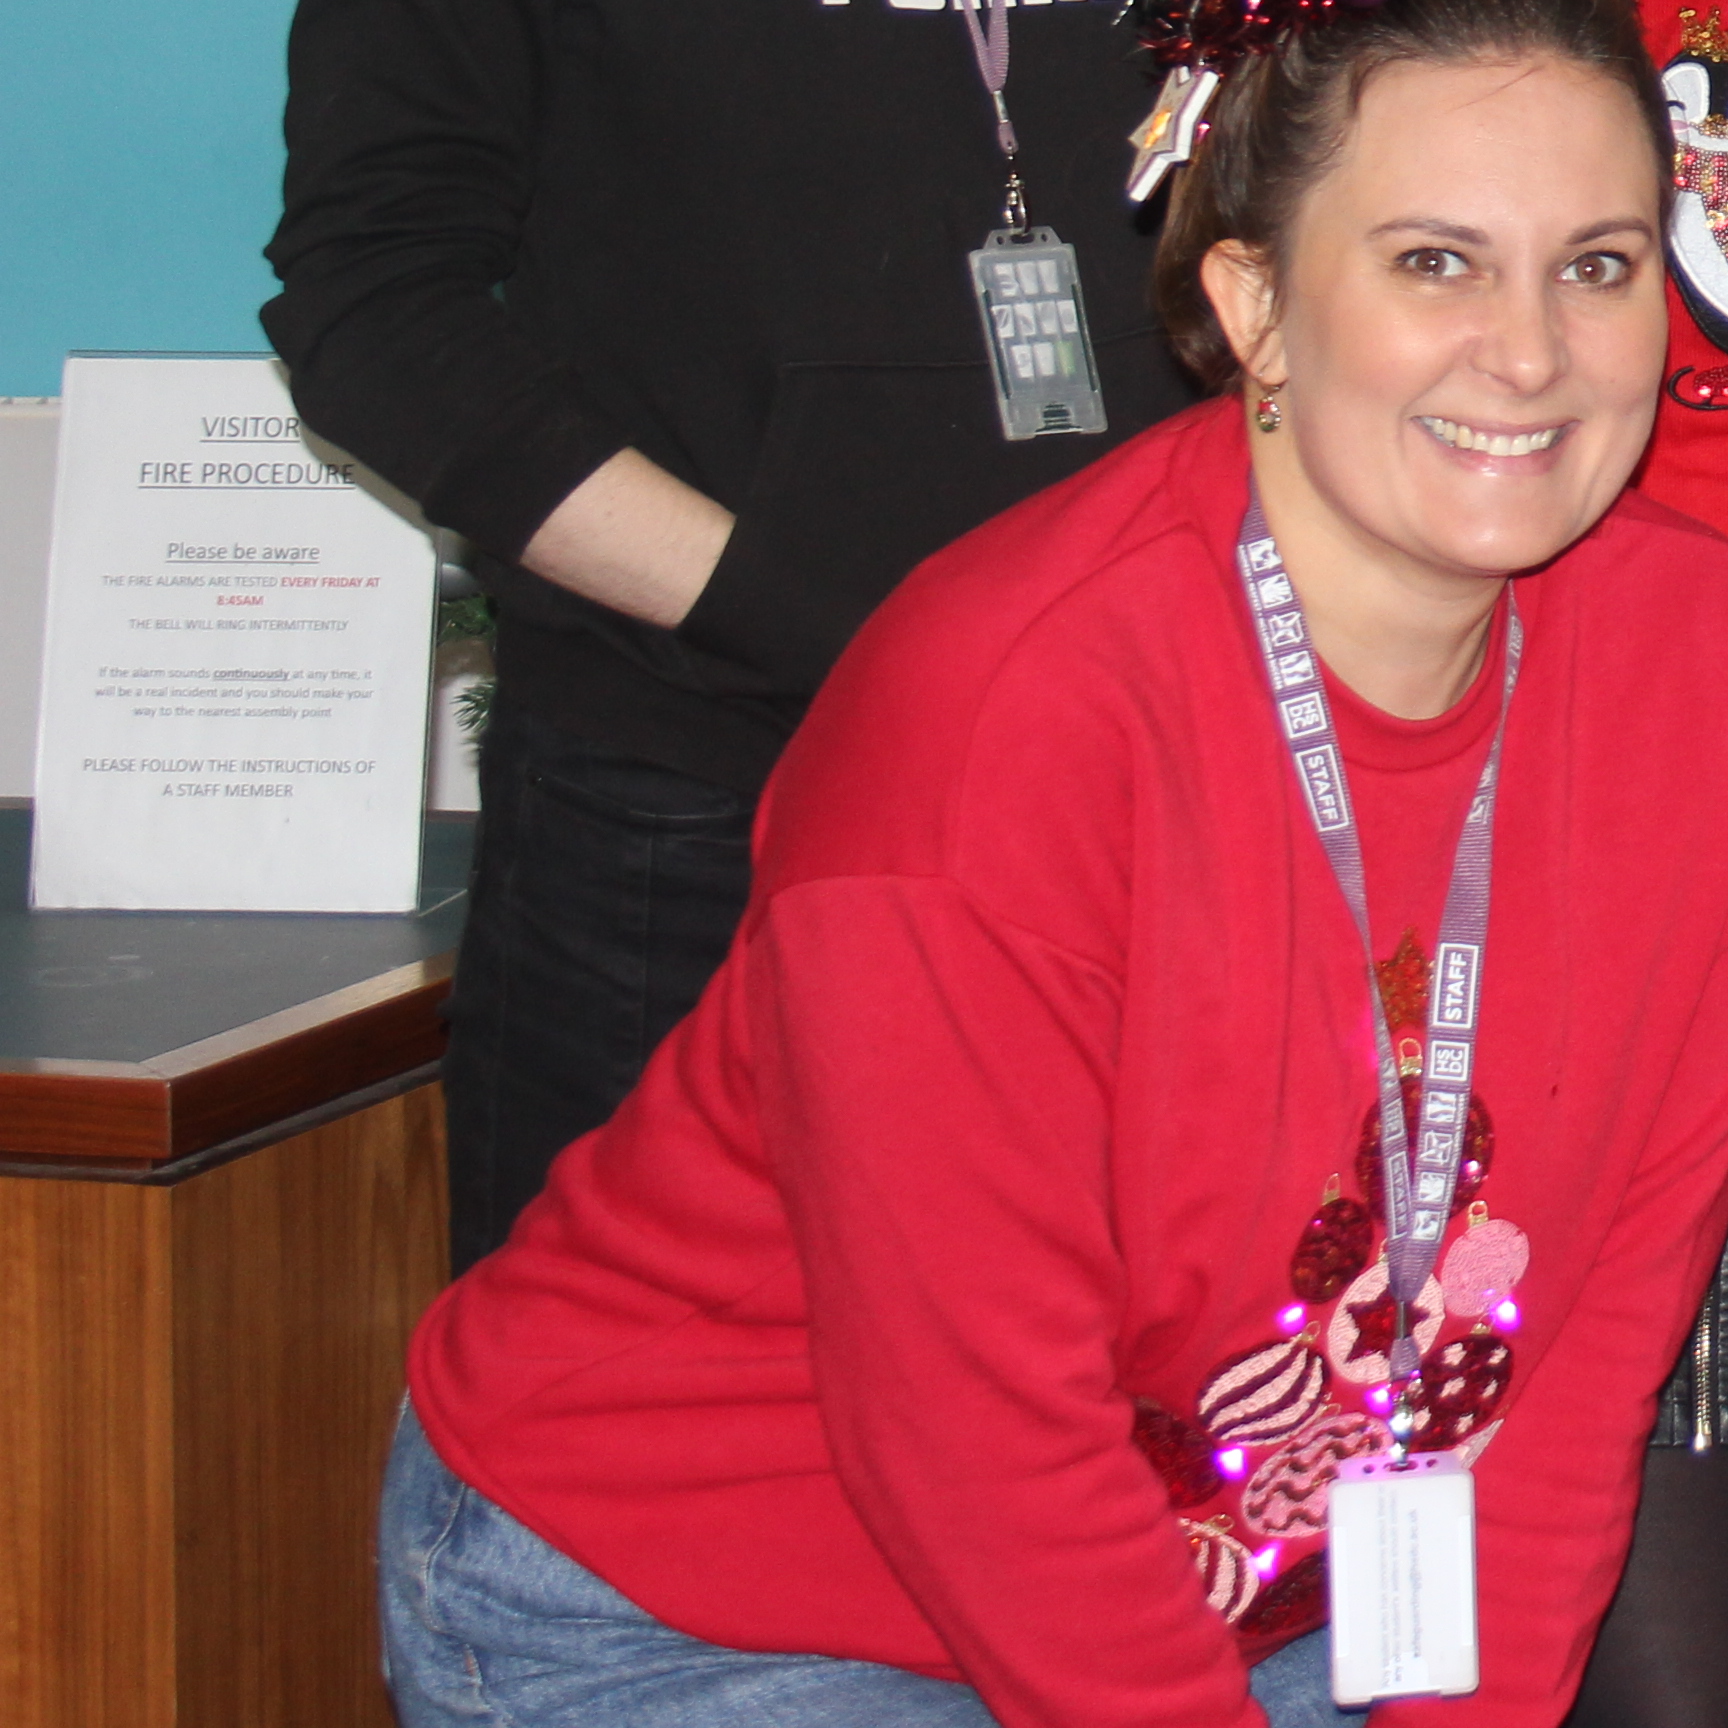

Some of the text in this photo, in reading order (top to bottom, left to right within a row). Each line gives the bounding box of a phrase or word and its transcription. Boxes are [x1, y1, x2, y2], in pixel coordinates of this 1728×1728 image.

[201, 416, 300, 440] VISITOR
[139, 461, 356, 486] FIRE PROCEDURE
[167, 542, 320, 560] Please be aware
[103, 575, 380, 588] THE FIRE ALARMS ARE TESTED EVERY FRIDAY AT
[216, 595, 264, 606] 8:45AM
[129, 618, 349, 631] THE BELL WILL RING INTERMITTENTLY
[110, 667, 129, 678] the
[132, 668, 166, 679] alarm
[168, 668, 210, 679] sounds
[213, 668, 290, 681] continuously
[292, 669, 305, 679] at
[95, 687, 115, 697] will
[117, 687, 132, 697] be
[134, 689, 142, 697] a
[145, 687, 168, 697] real
[170, 687, 218, 698] incident
[221, 687, 243, 698] and
[270, 688, 310, 699] should
[312, 688, 344, 699] make
[347, 690, 374, 701] your
[133, 708, 156, 719] way
[160, 706, 173, 717] to
[175, 706, 196, 717] the
[245, 706, 298, 719] assembly
[302, 707, 332, 719] point
[1288, 704, 1306, 730] DC
[1302, 699, 1320, 724] HS
[83, 758, 377, 774] PLEASE FOLLOW THE INSTRUCTIONS OF
[163, 784, 293, 798] A STAFF MEMBER
[1307, 754, 1338, 822] STAFF
[1445, 951, 1467, 1021] STAFF
[1435, 1047, 1450, 1073] HS
[1449, 1047, 1465, 1073] DC
